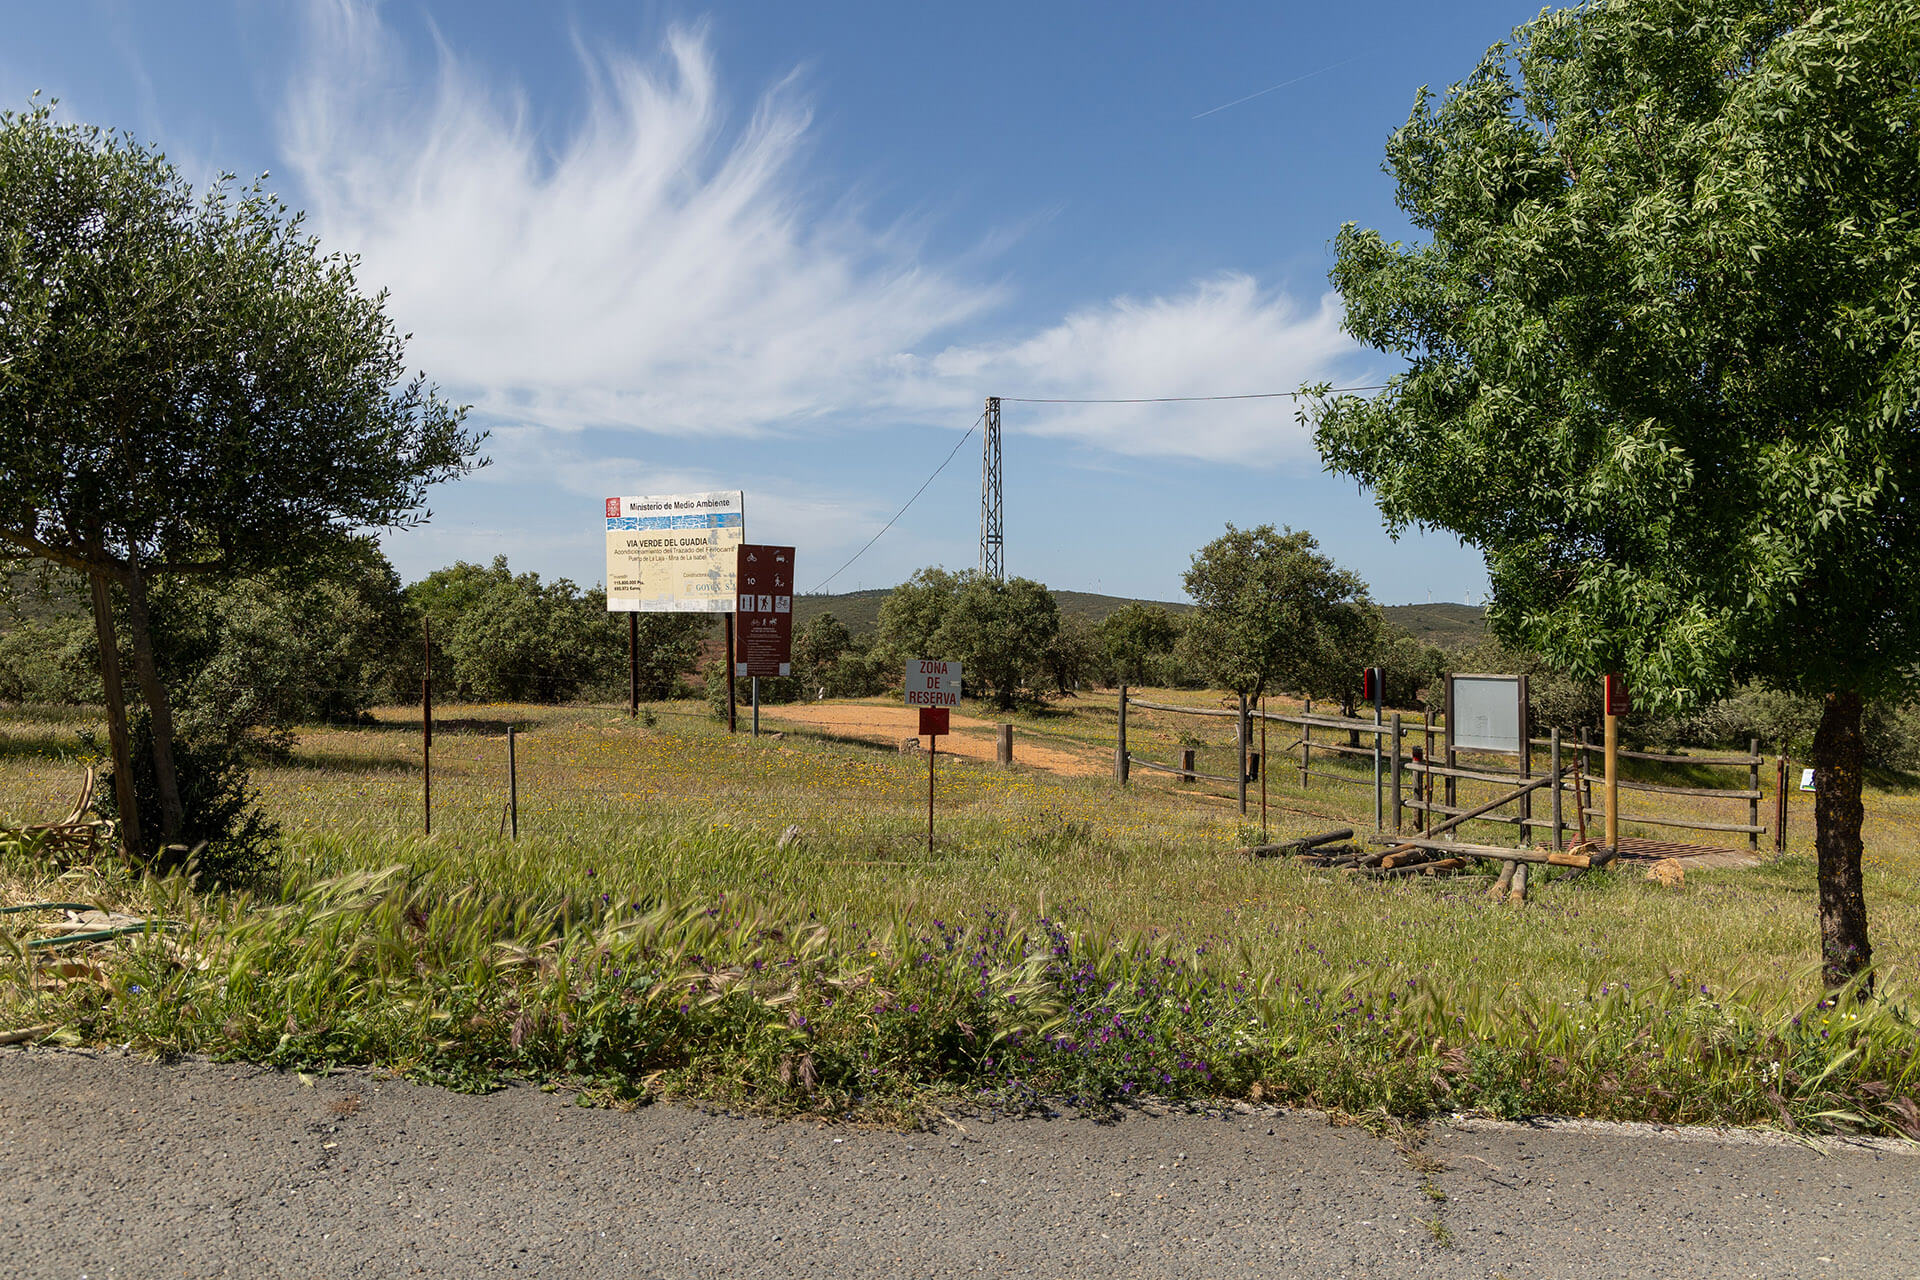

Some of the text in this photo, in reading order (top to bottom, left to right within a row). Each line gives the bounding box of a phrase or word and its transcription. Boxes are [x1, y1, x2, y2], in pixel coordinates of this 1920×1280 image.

[630, 499, 730, 511] Ministerio de Medio Ambiente
[639, 539, 663, 547] VERDE
[664, 538, 679, 546] DEL
[747, 577, 756, 585] 10
[920, 661, 948, 674] ZONA
[927, 676, 940, 689] DE
[909, 691, 957, 704] RESERVA
